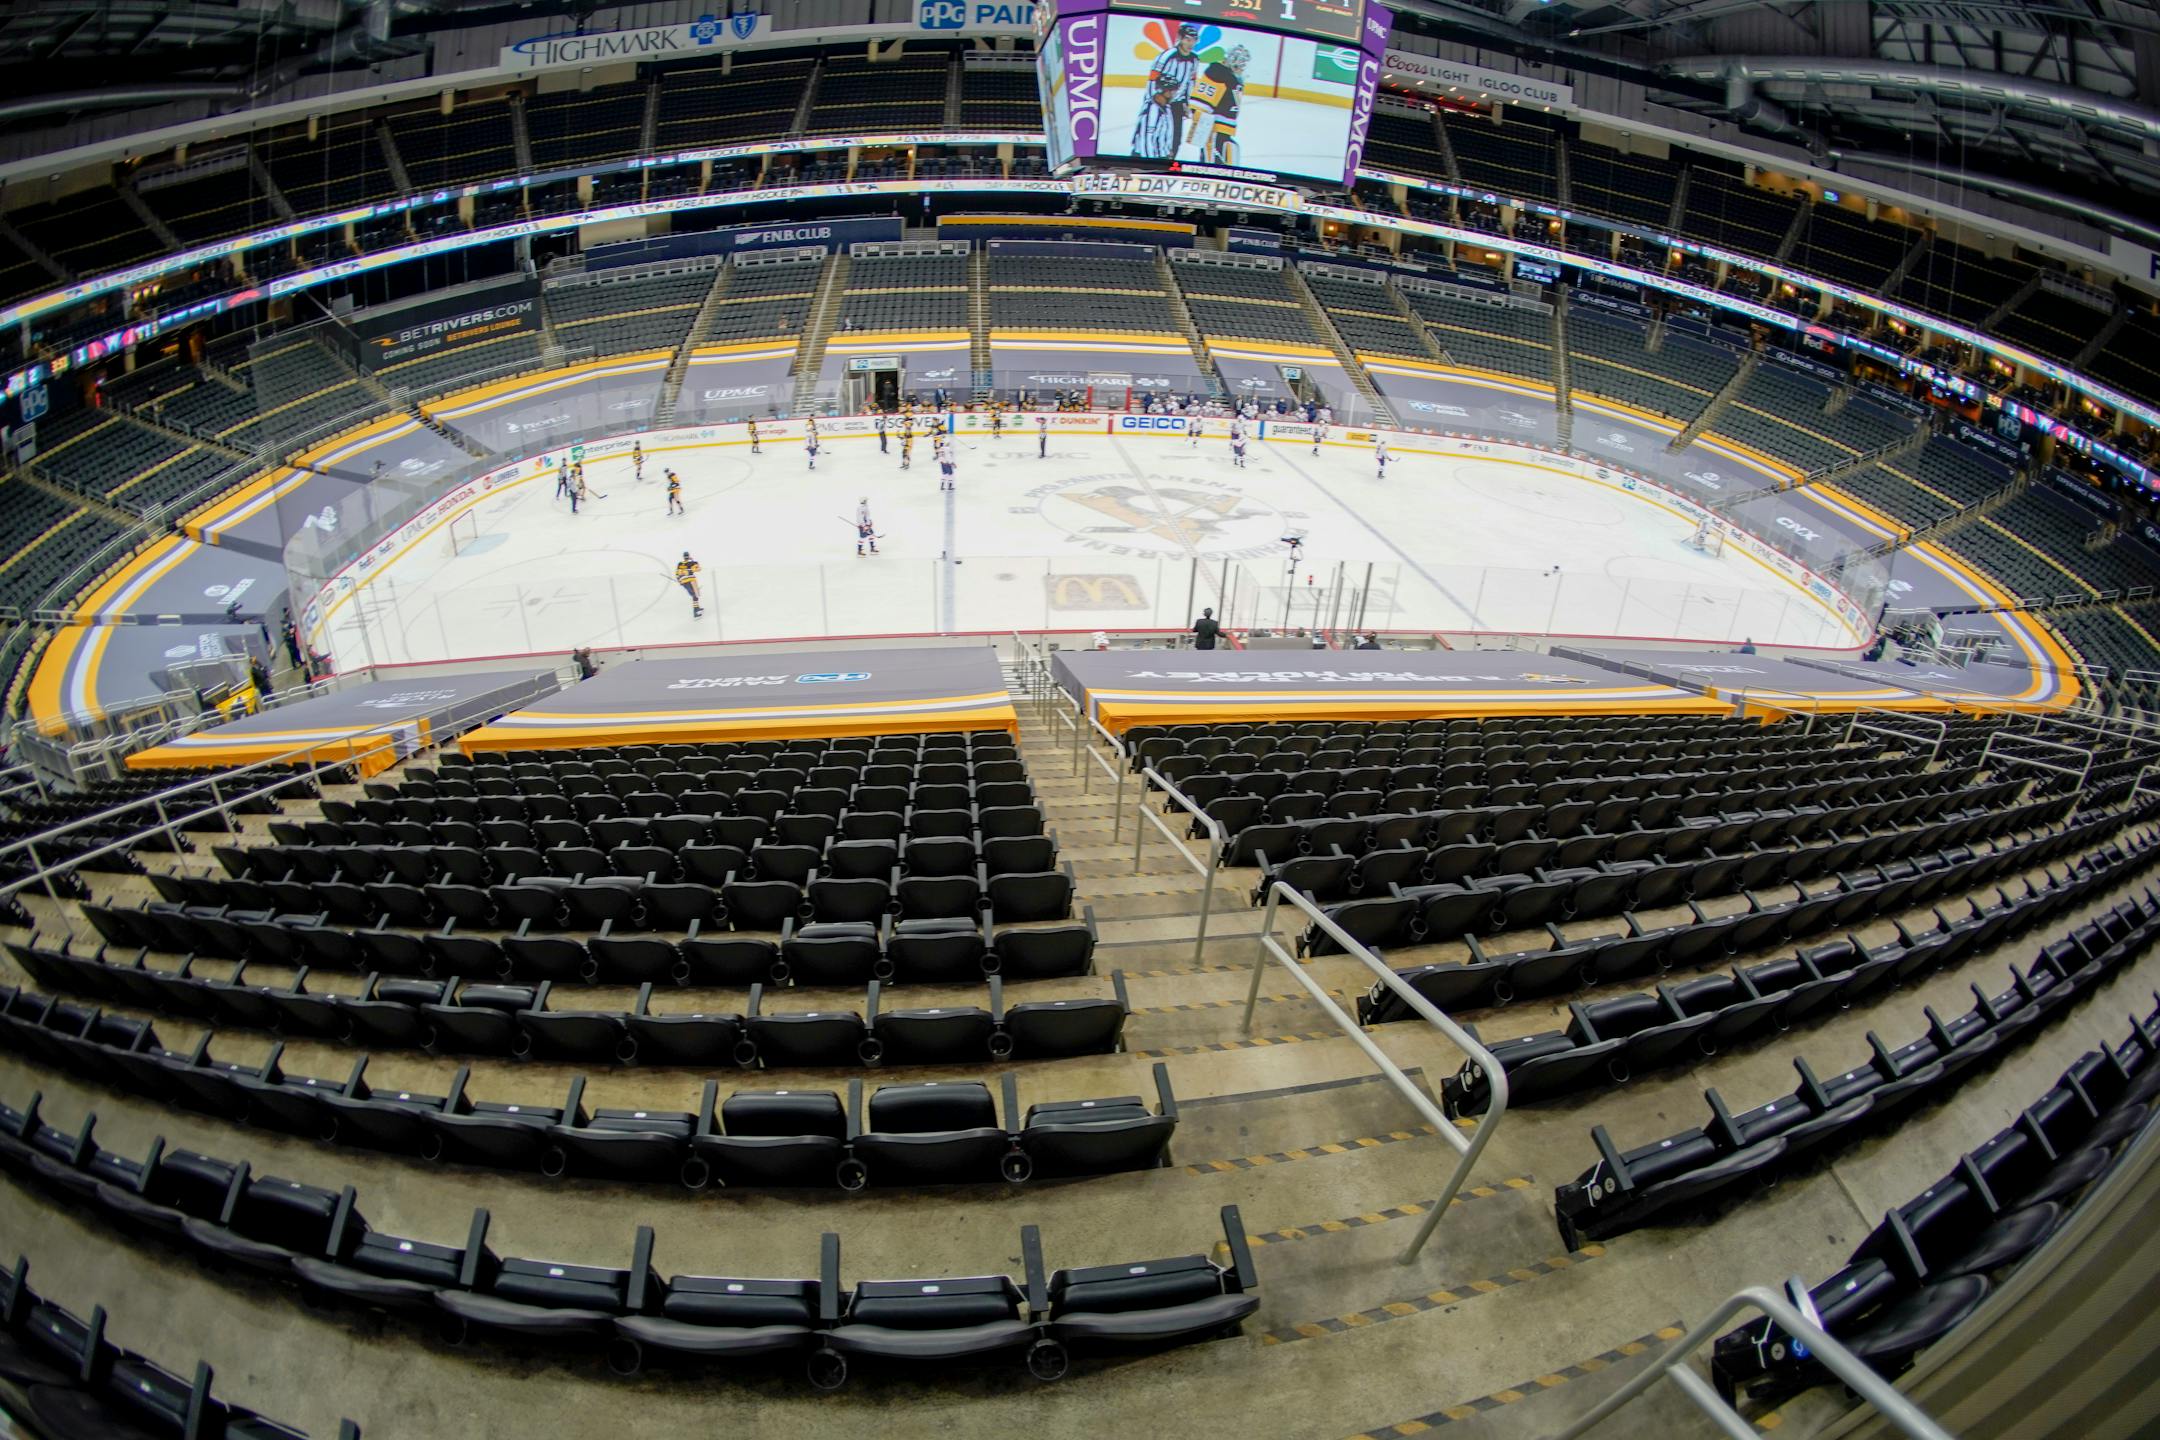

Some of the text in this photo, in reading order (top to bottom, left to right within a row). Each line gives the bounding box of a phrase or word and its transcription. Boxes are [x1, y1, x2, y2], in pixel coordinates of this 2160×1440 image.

[529, 28, 680, 67] HIGHMARK
[1067, 16, 1099, 143] UPMC
[1384, 52, 1559, 103] Coors LIGHT IGLOO CLUB
[1197, 81, 1216, 98] 35
[1345, 59, 1380, 171] UPMC
[1138, 177, 1179, 193] DAY
[1180, 180, 1210, 193] FOR
[1213, 183, 1288, 208] HOCKEY
[400, 302, 532, 343] BETRIVERS.COM
[382, 340, 415, 361] COMING
[417, 337, 441, 351] SOON
[1803, 334, 1836, 355] FedEx
[1040, 373, 1134, 387] HIGHMARK
[704, 385, 769, 400] UPMC
[1122, 416, 1187, 430] GEICO
[437, 487, 476, 516] HONDA
[1775, 516, 1822, 542] CNX
[379, 540, 396, 557] FedEx
[359, 554, 377, 571] FedEx
[677, 674, 790, 685] ARENA
[1126, 670, 1338, 680] HOCKEY
[1187, 675, 1302, 683] DAY
[1320, 674, 1473, 682] GREAT
